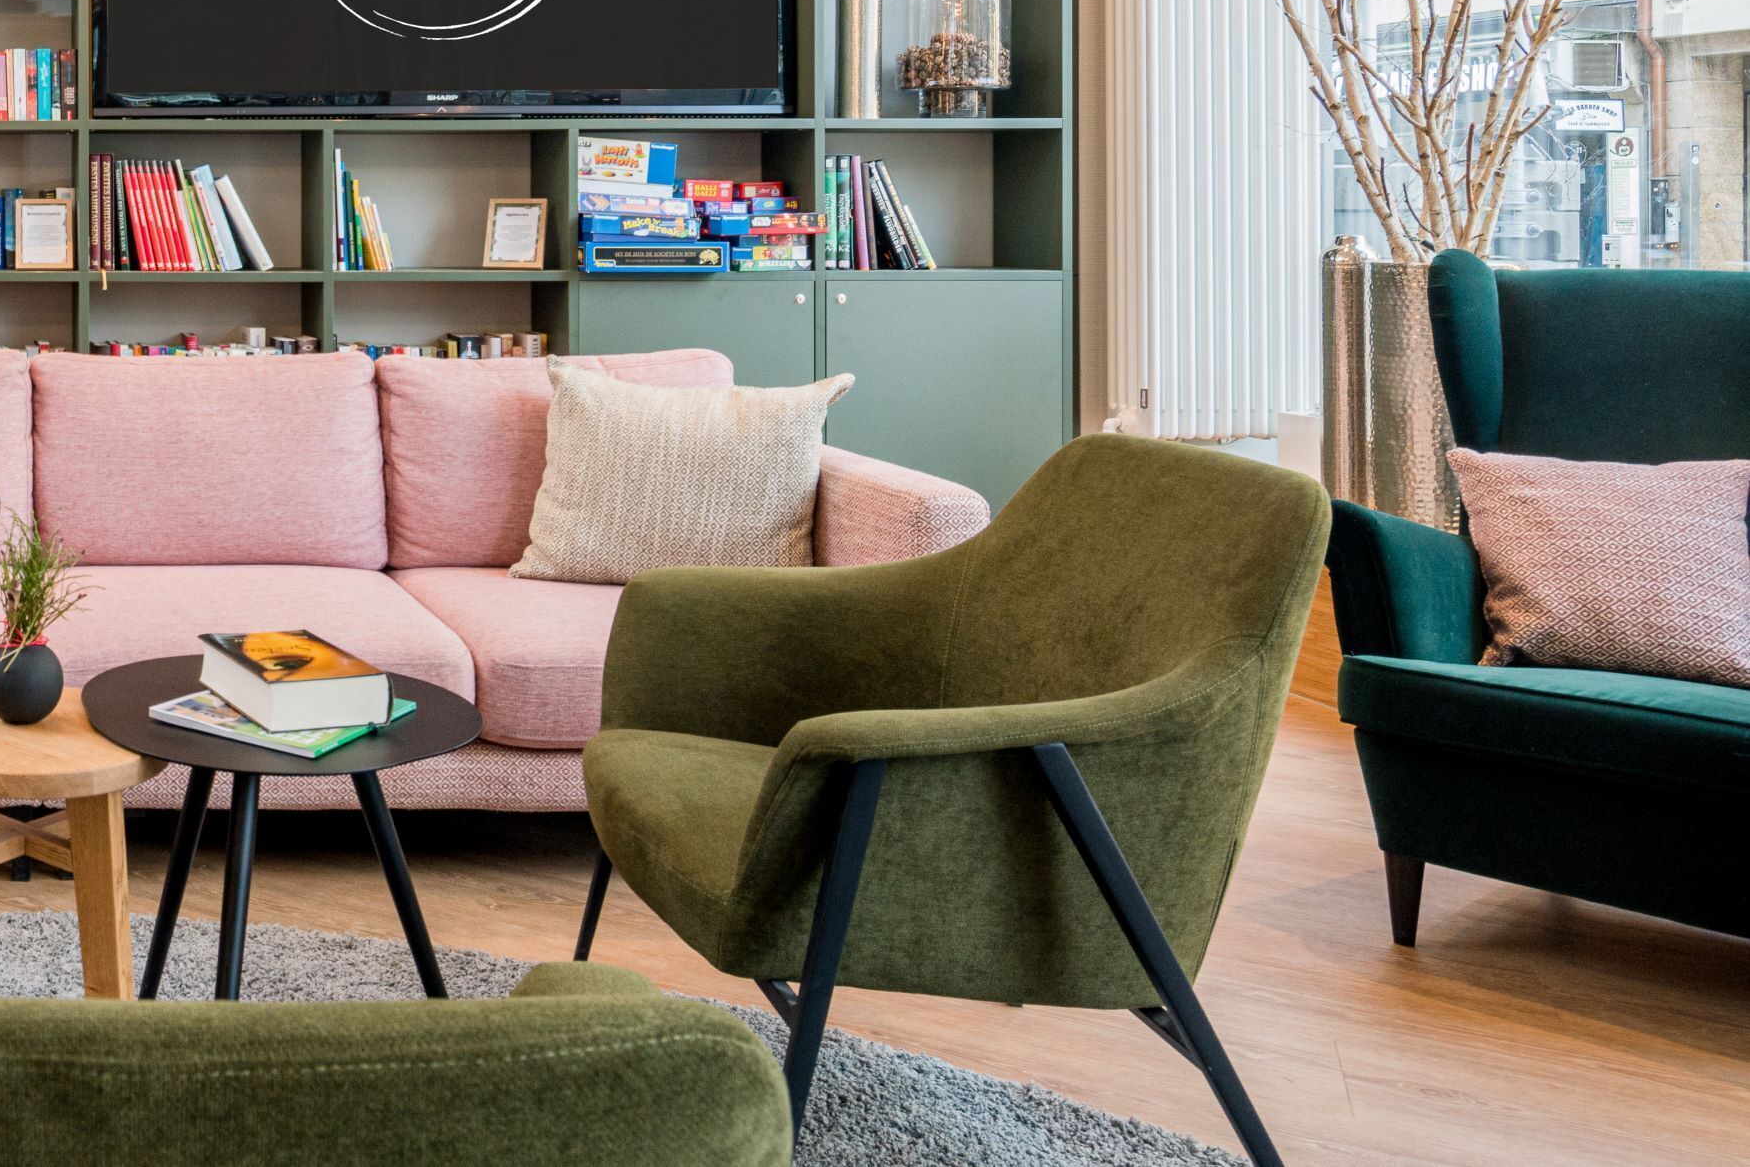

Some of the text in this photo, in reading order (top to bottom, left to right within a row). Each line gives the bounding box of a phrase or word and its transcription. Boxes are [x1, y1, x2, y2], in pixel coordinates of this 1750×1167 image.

[91, 161, 99, 245] ERSTES JAHRTAUSEND
[103, 161, 112, 250] ZWEITES JAHRTAUSEND
[622, 217, 651, 230] Make
[648, 223, 680, 236] Break
